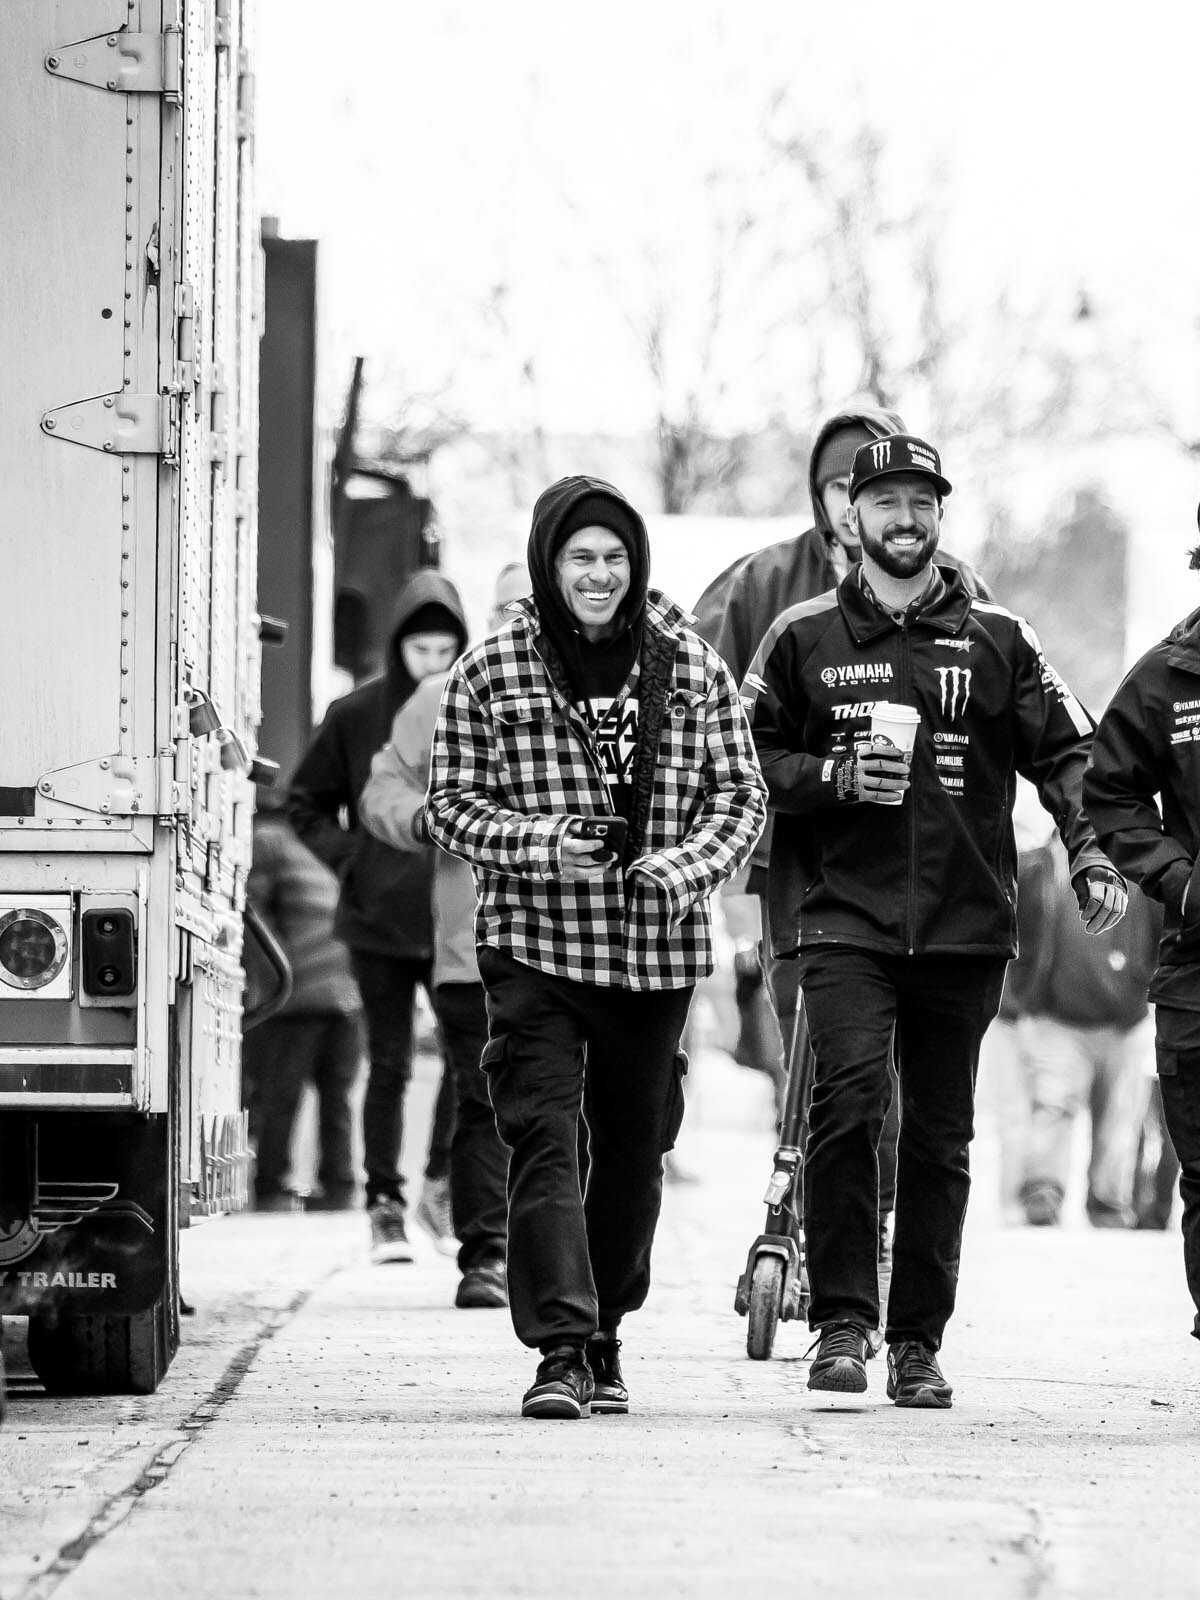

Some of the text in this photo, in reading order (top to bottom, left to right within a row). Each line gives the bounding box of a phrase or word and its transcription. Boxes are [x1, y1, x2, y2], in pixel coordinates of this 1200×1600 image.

[836, 662, 894, 681] YAMAHA
[831, 700, 889, 721] THO
[942, 732, 970, 745] YAMAHA
[17, 1271, 118, 1289] TRAILER
